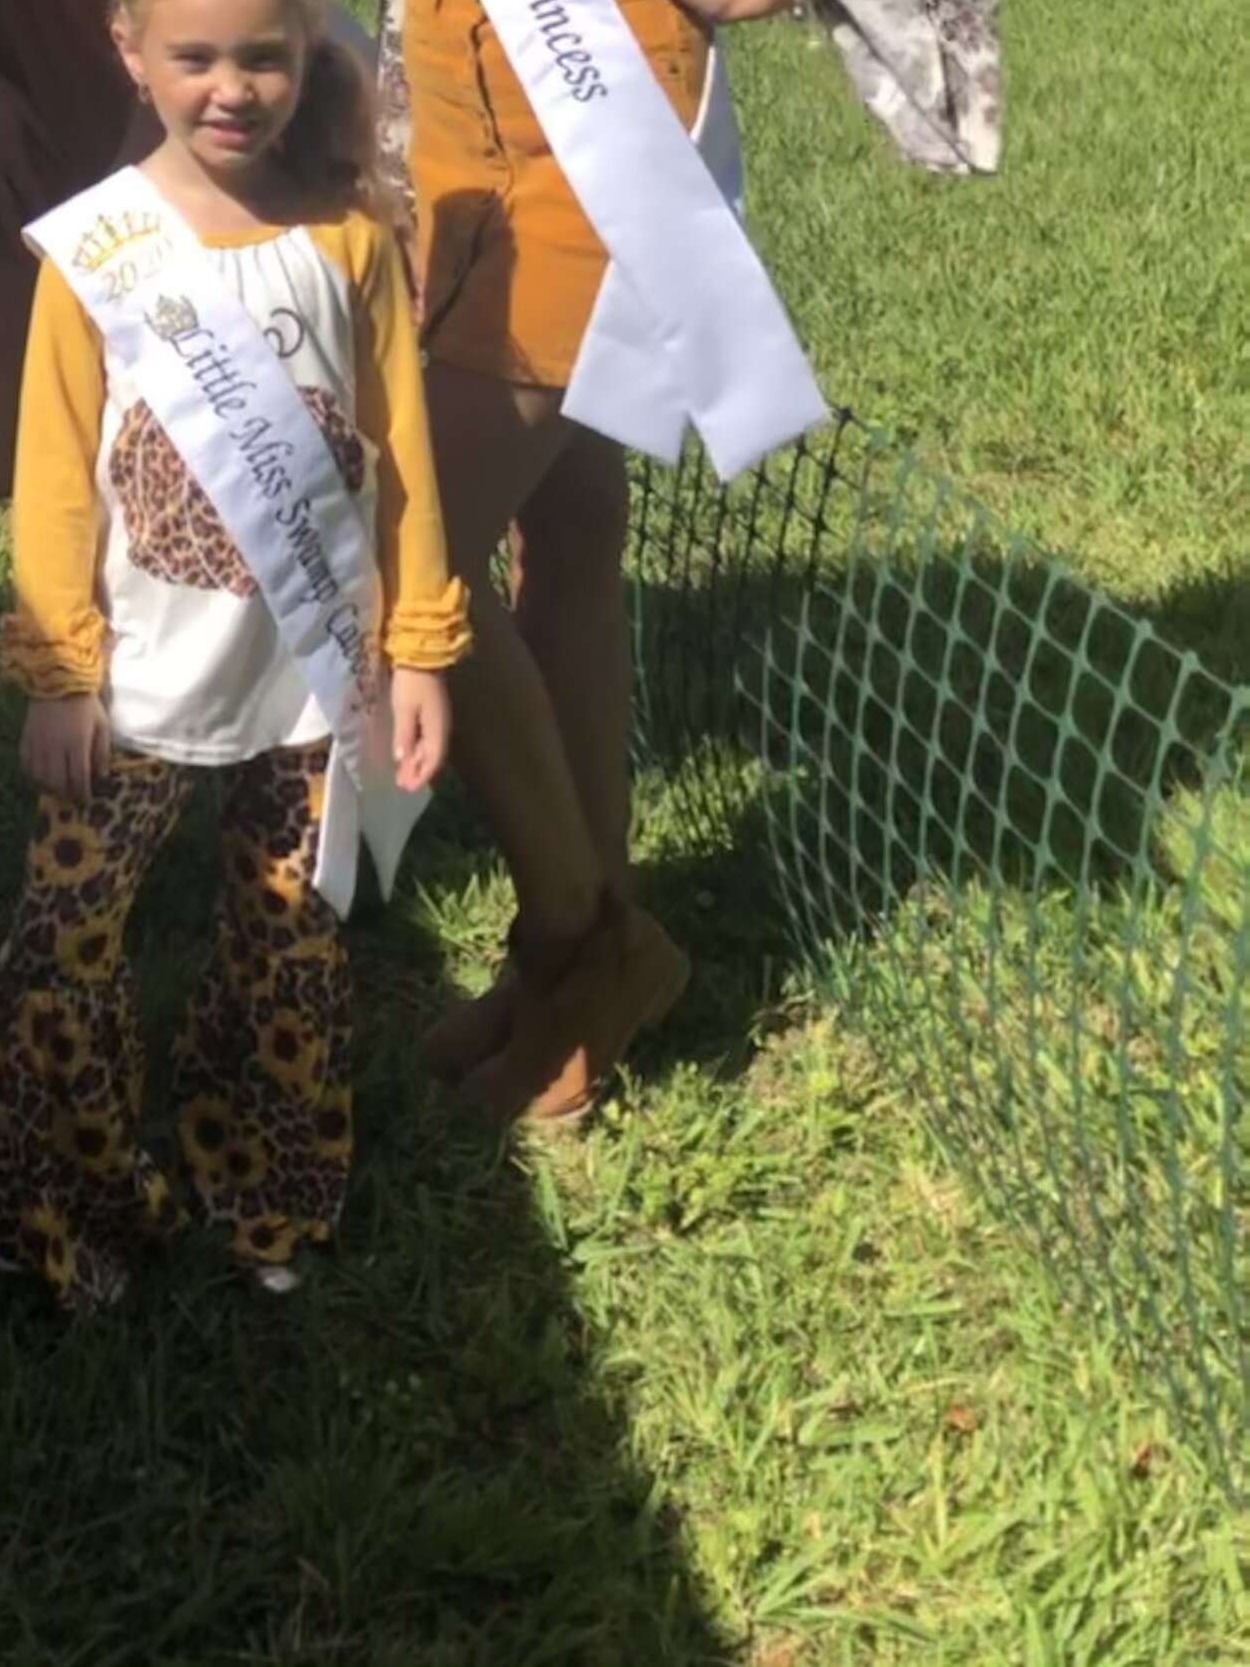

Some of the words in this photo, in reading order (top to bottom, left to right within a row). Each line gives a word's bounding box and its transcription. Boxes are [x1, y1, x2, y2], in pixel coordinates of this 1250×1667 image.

[170, 326, 248, 420] Little
[230, 417, 295, 502] Miss
[275, 498, 339, 605] Swamp
